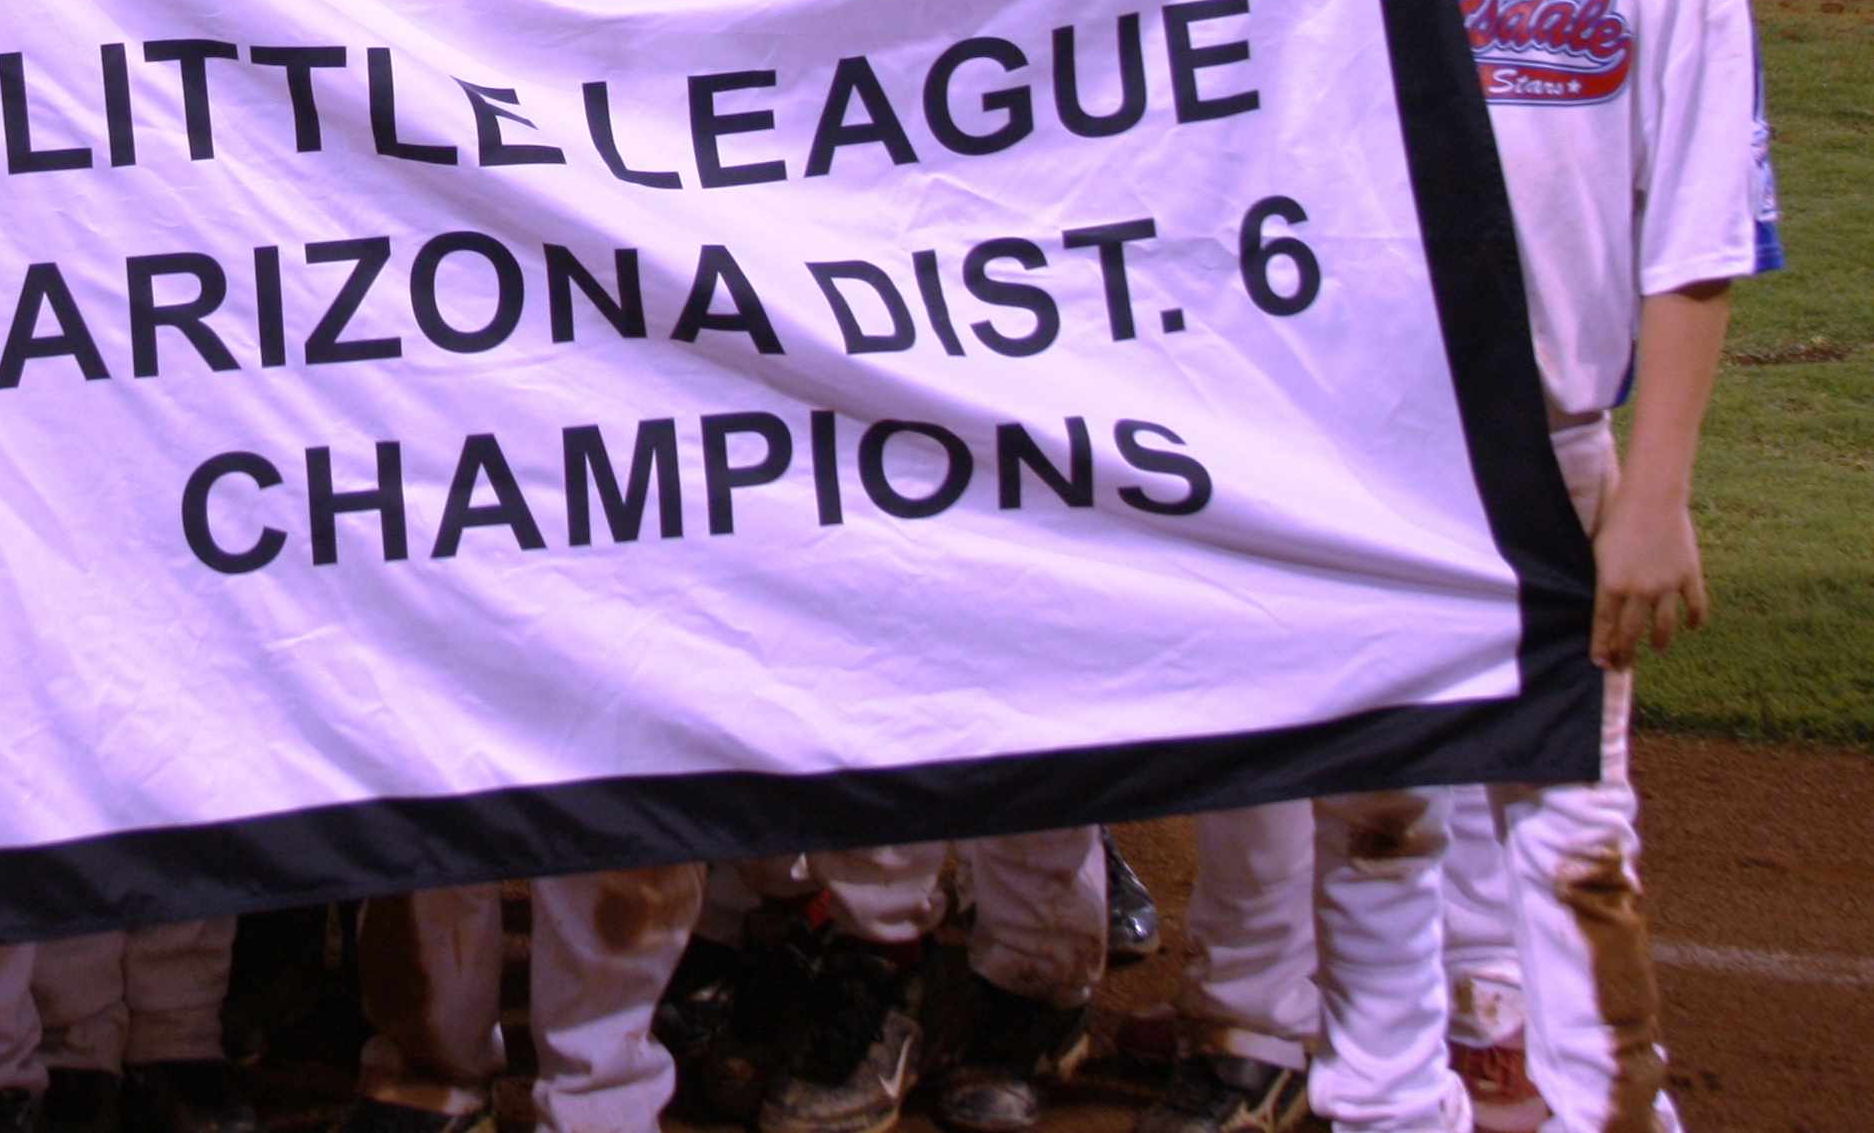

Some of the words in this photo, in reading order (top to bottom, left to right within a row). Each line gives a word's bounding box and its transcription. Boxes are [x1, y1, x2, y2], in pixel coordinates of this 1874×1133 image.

[1488, 68, 1564, 96] Stars
[805, 218, 1187, 357] DIST.
[1238, 195, 1322, 317] 6
[181, 410, 1213, 575] CHAMPIONS
